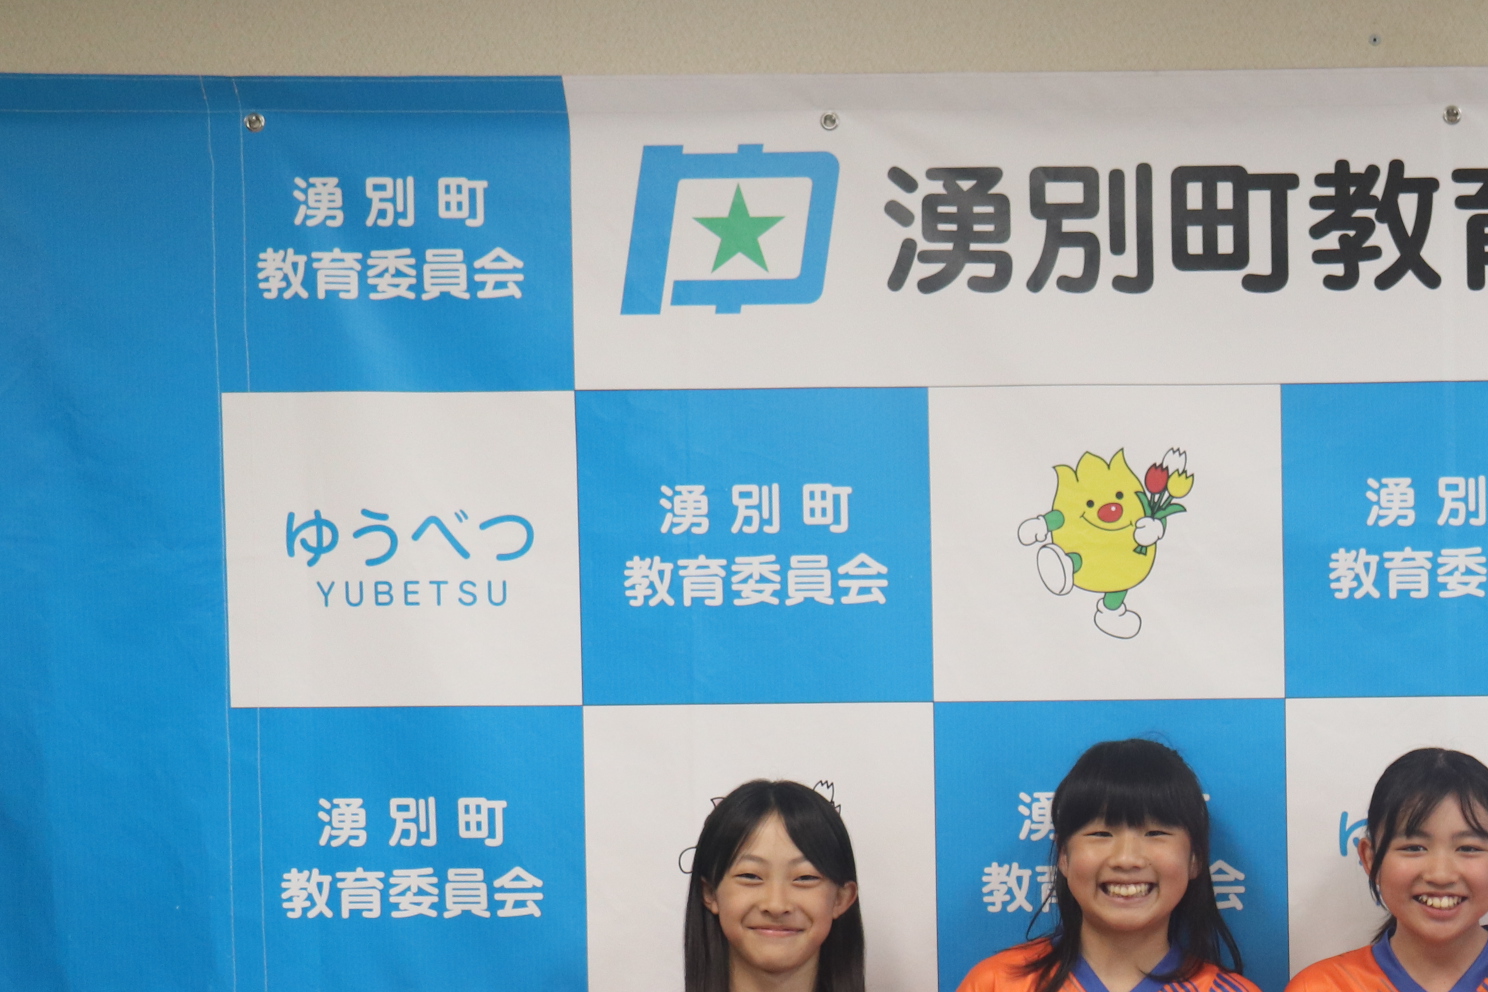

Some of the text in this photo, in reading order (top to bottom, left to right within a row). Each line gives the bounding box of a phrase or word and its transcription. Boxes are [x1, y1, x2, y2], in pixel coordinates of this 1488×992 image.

[292, 175, 489, 228] 湧別町
[256, 246, 525, 301] 教育委員会
[659, 482, 853, 535] 湧別町
[285, 508, 535, 568] ゆうべつ
[316, 580, 507, 608] YUBETSU
[623, 552, 889, 607] 教育委員会
[317, 796, 508, 848] 湧別町
[280, 866, 544, 919] 教育委員会
